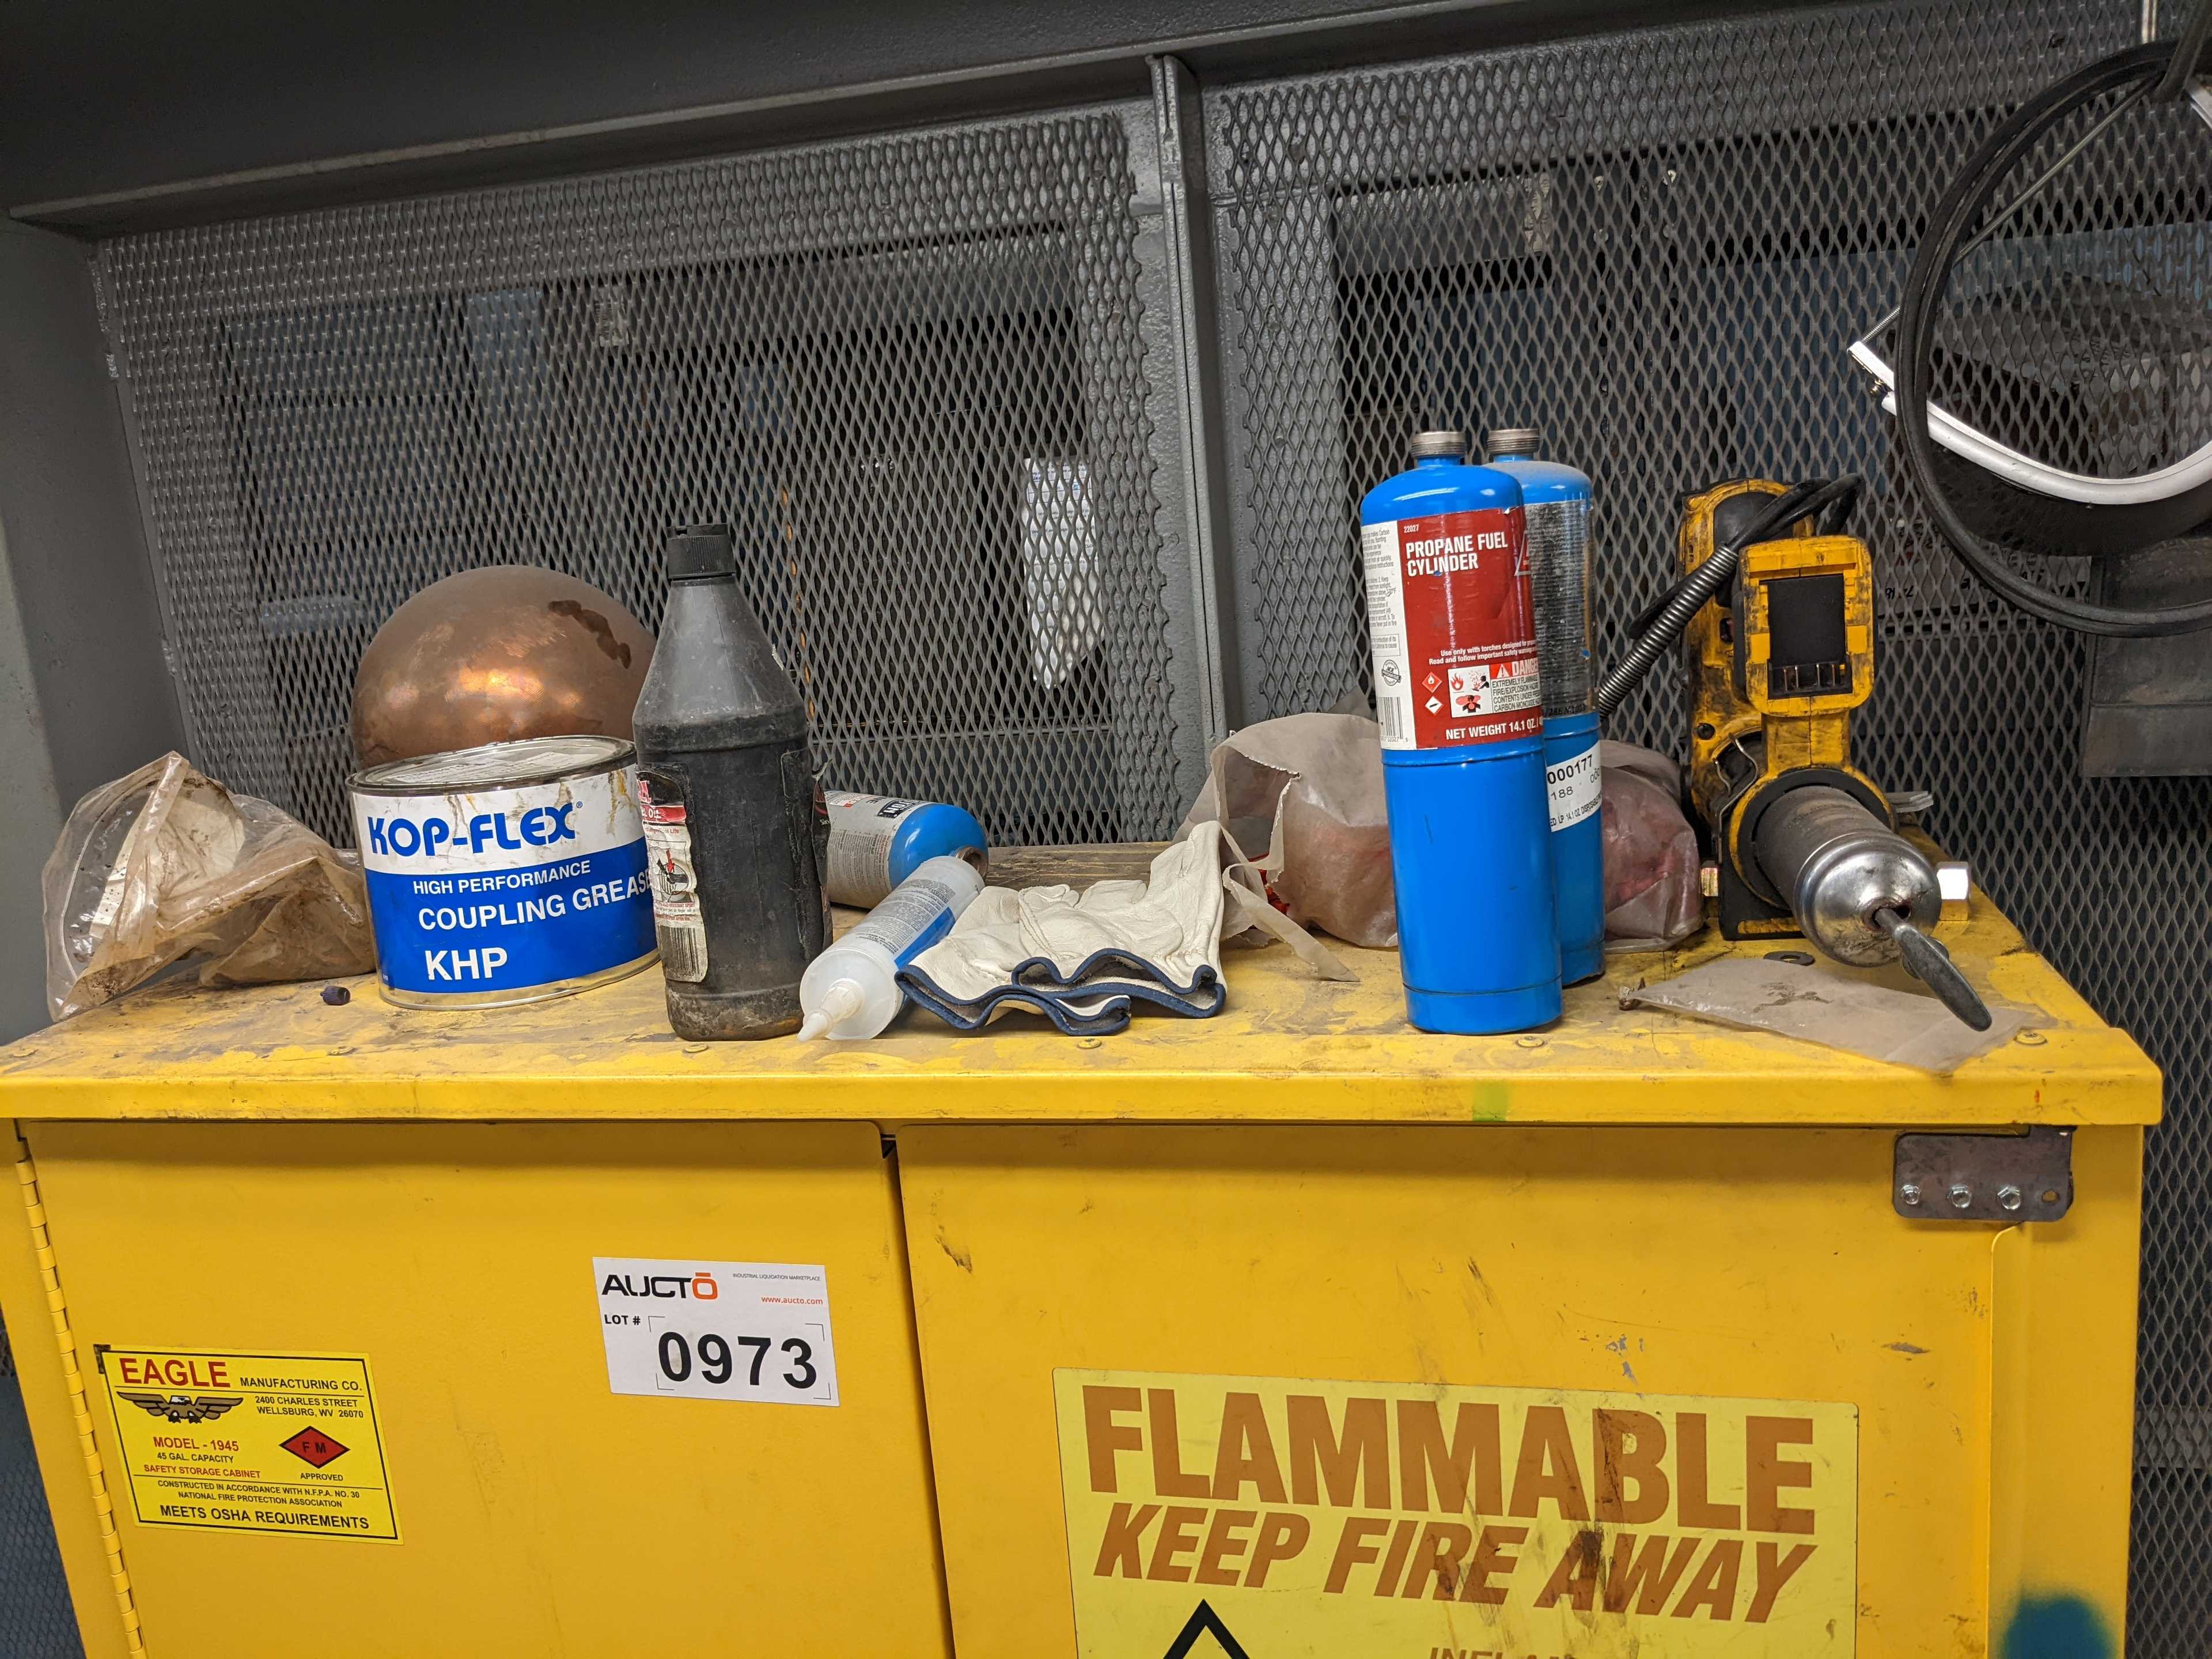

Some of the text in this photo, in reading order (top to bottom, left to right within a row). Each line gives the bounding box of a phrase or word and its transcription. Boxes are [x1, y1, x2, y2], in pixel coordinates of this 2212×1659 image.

[1403, 524, 1419, 533] 22027
[1406, 532, 1508, 559] PROPANE FUEL
[1407, 552, 1479, 577] CYLINDER
[1502, 641, 1521, 649] designed
[1477, 652, 1503, 660] important
[1492, 677, 1520, 688] EXTREMELY
[1493, 685, 1529, 696] FIRE/EXPLOSION
[1494, 694, 1520, 704] CONTENTS
[1494, 703, 1516, 711] CARBON
[1446, 728, 1466, 740] NET
[1469, 723, 1506, 737] WEIGHT
[1509, 720, 1525, 732] 14.1
[1527, 718, 1536, 729] OZ.
[1547, 754, 1593, 785] 000177
[1550, 786, 1573, 801] 188
[1558, 815, 1564, 824] LP
[1574, 808, 1580, 817] OZ
[368, 802, 575, 857] KOP-FLEX
[414, 860, 590, 895] HIGH PERFORMANCE
[419, 895, 566, 930] COUPLING
[425, 946, 507, 980] KHP
[762, 1297, 823, 1305] www.aucto.com
[604, 1314, 641, 1325] LOT #
[658, 1331, 817, 1389] 0973
[120, 1358, 362, 1391] EAGLE MANUFACTURING CO.
[255, 1396, 357, 1407] 2400 CHARLES STREET
[257, 1406, 363, 1418] WELLSBURG, WV 26070
[153, 1437, 199, 1449] MODEL
[211, 1440, 239, 1452] 1945
[191, 1454, 233, 1463] CAPACITY
[1082, 1384, 1815, 1536] FLAMMABLE
[144, 1464, 260, 1478] SAFETY STORAGE CABINET
[300, 1472, 343, 1482] APPROVED
[158, 1480, 214, 1490] CONSTRUCTED
[226, 1484, 281, 1494] ACCORDANCE
[305, 1488, 332, 1497] N.F.P.A.
[178, 1491, 217, 1500] NATIONAL
[237, 1495, 286, 1504] PROTECTION
[289, 1498, 342, 1507] ASSOCIATION
[160, 1505, 369, 1529] MEETS OSHA REQUIREMENTS
[1093, 1502, 1818, 1624] KEEP FIRE AWAY
